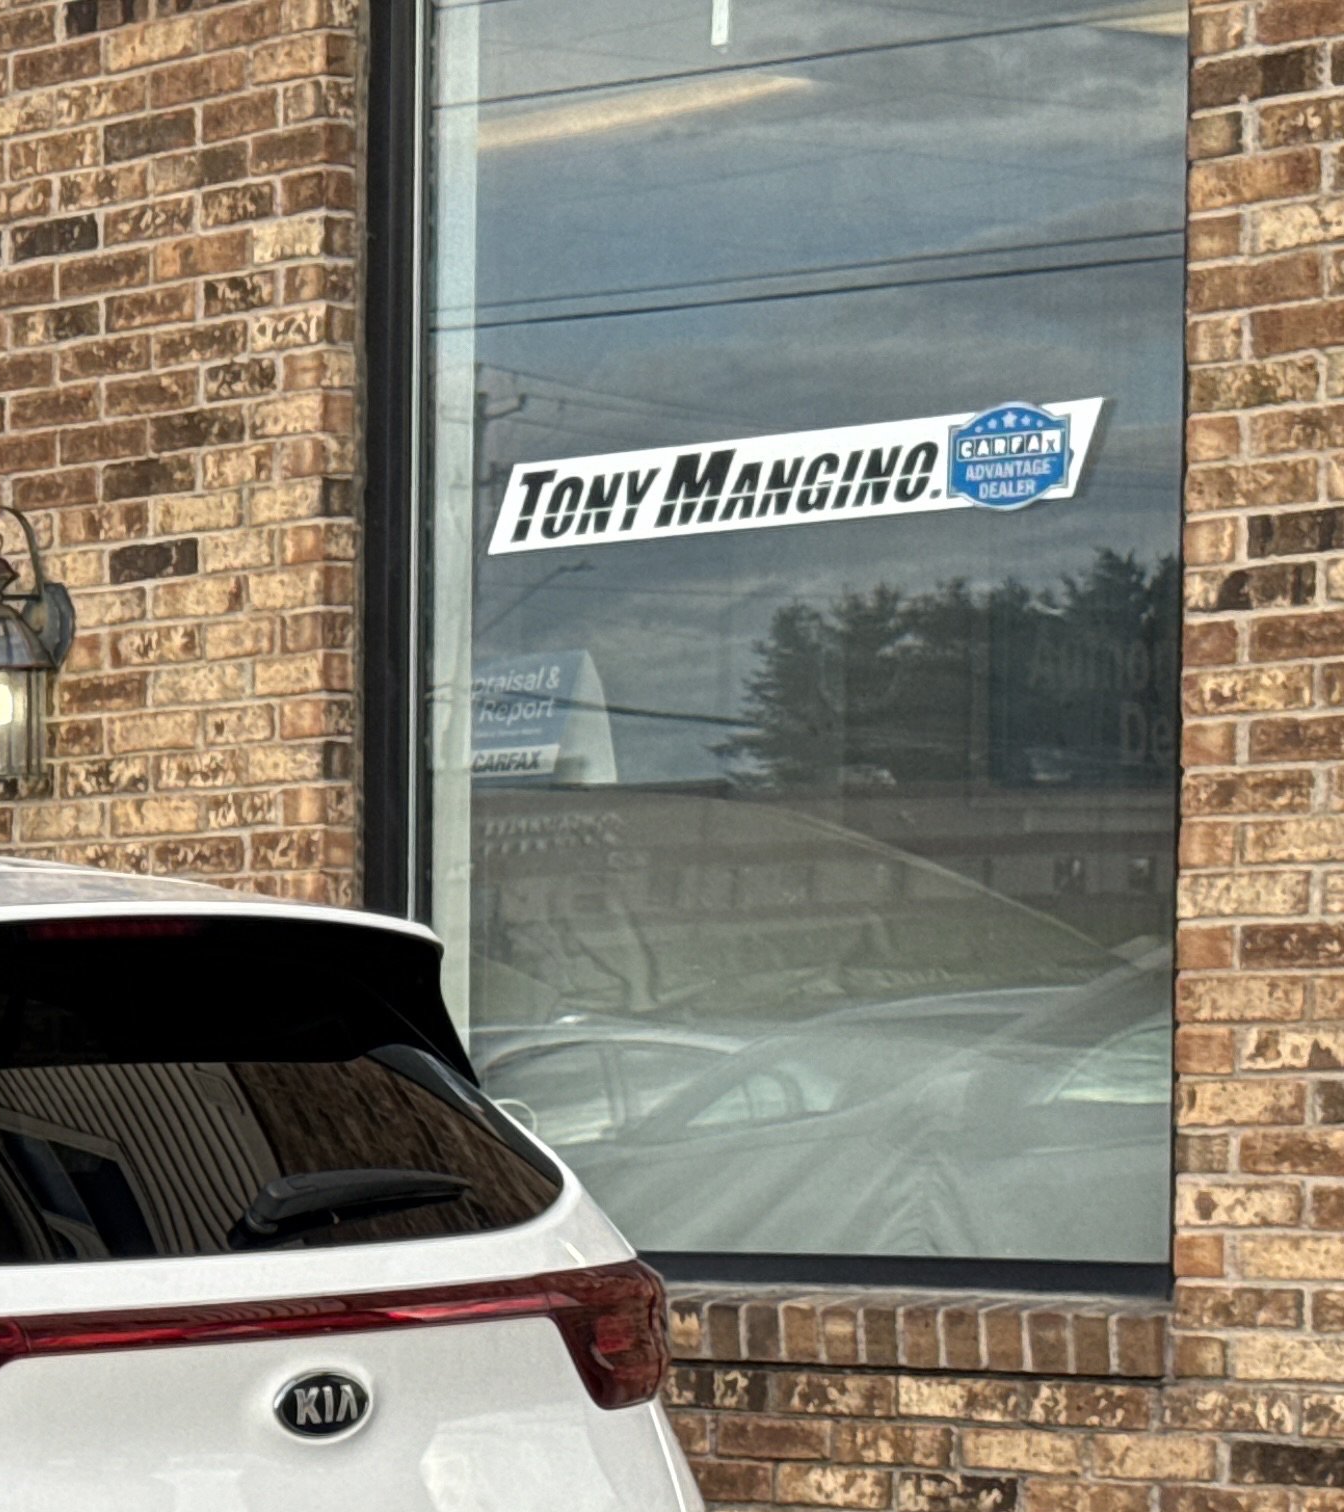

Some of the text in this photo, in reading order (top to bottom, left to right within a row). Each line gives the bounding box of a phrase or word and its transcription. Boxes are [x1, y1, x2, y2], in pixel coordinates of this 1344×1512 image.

[960, 432, 1058, 459] CARFAX
[966, 459, 1052, 481] ADVANTAGE
[979, 479, 1036, 499] DEALER
[511, 468, 661, 542] TONY
[294, 1384, 358, 1425] KIA
